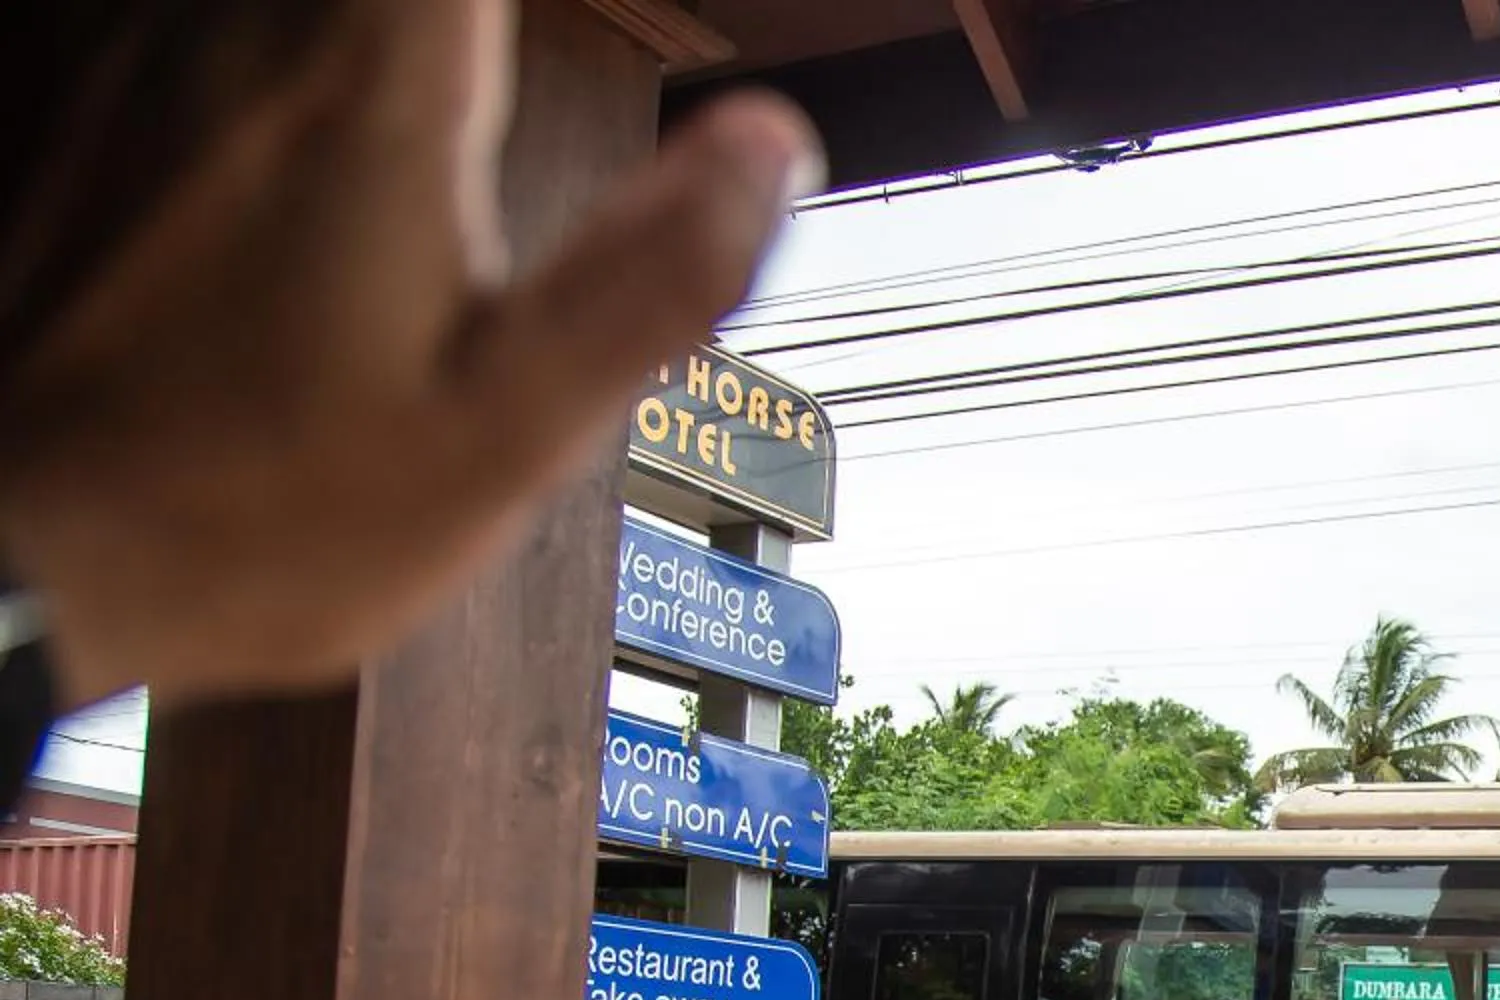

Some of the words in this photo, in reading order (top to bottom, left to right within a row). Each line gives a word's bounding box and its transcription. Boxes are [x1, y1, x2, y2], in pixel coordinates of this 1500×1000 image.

[687, 355, 816, 451] HORSE
[637, 397, 737, 477] OTEL
[617, 577, 787, 667] onference
[754, 589, 775, 627] &
[604, 727, 701, 785] ooms
[664, 797, 725, 838] non
[733, 807, 793, 850] A/C
[743, 955, 762, 992] &
